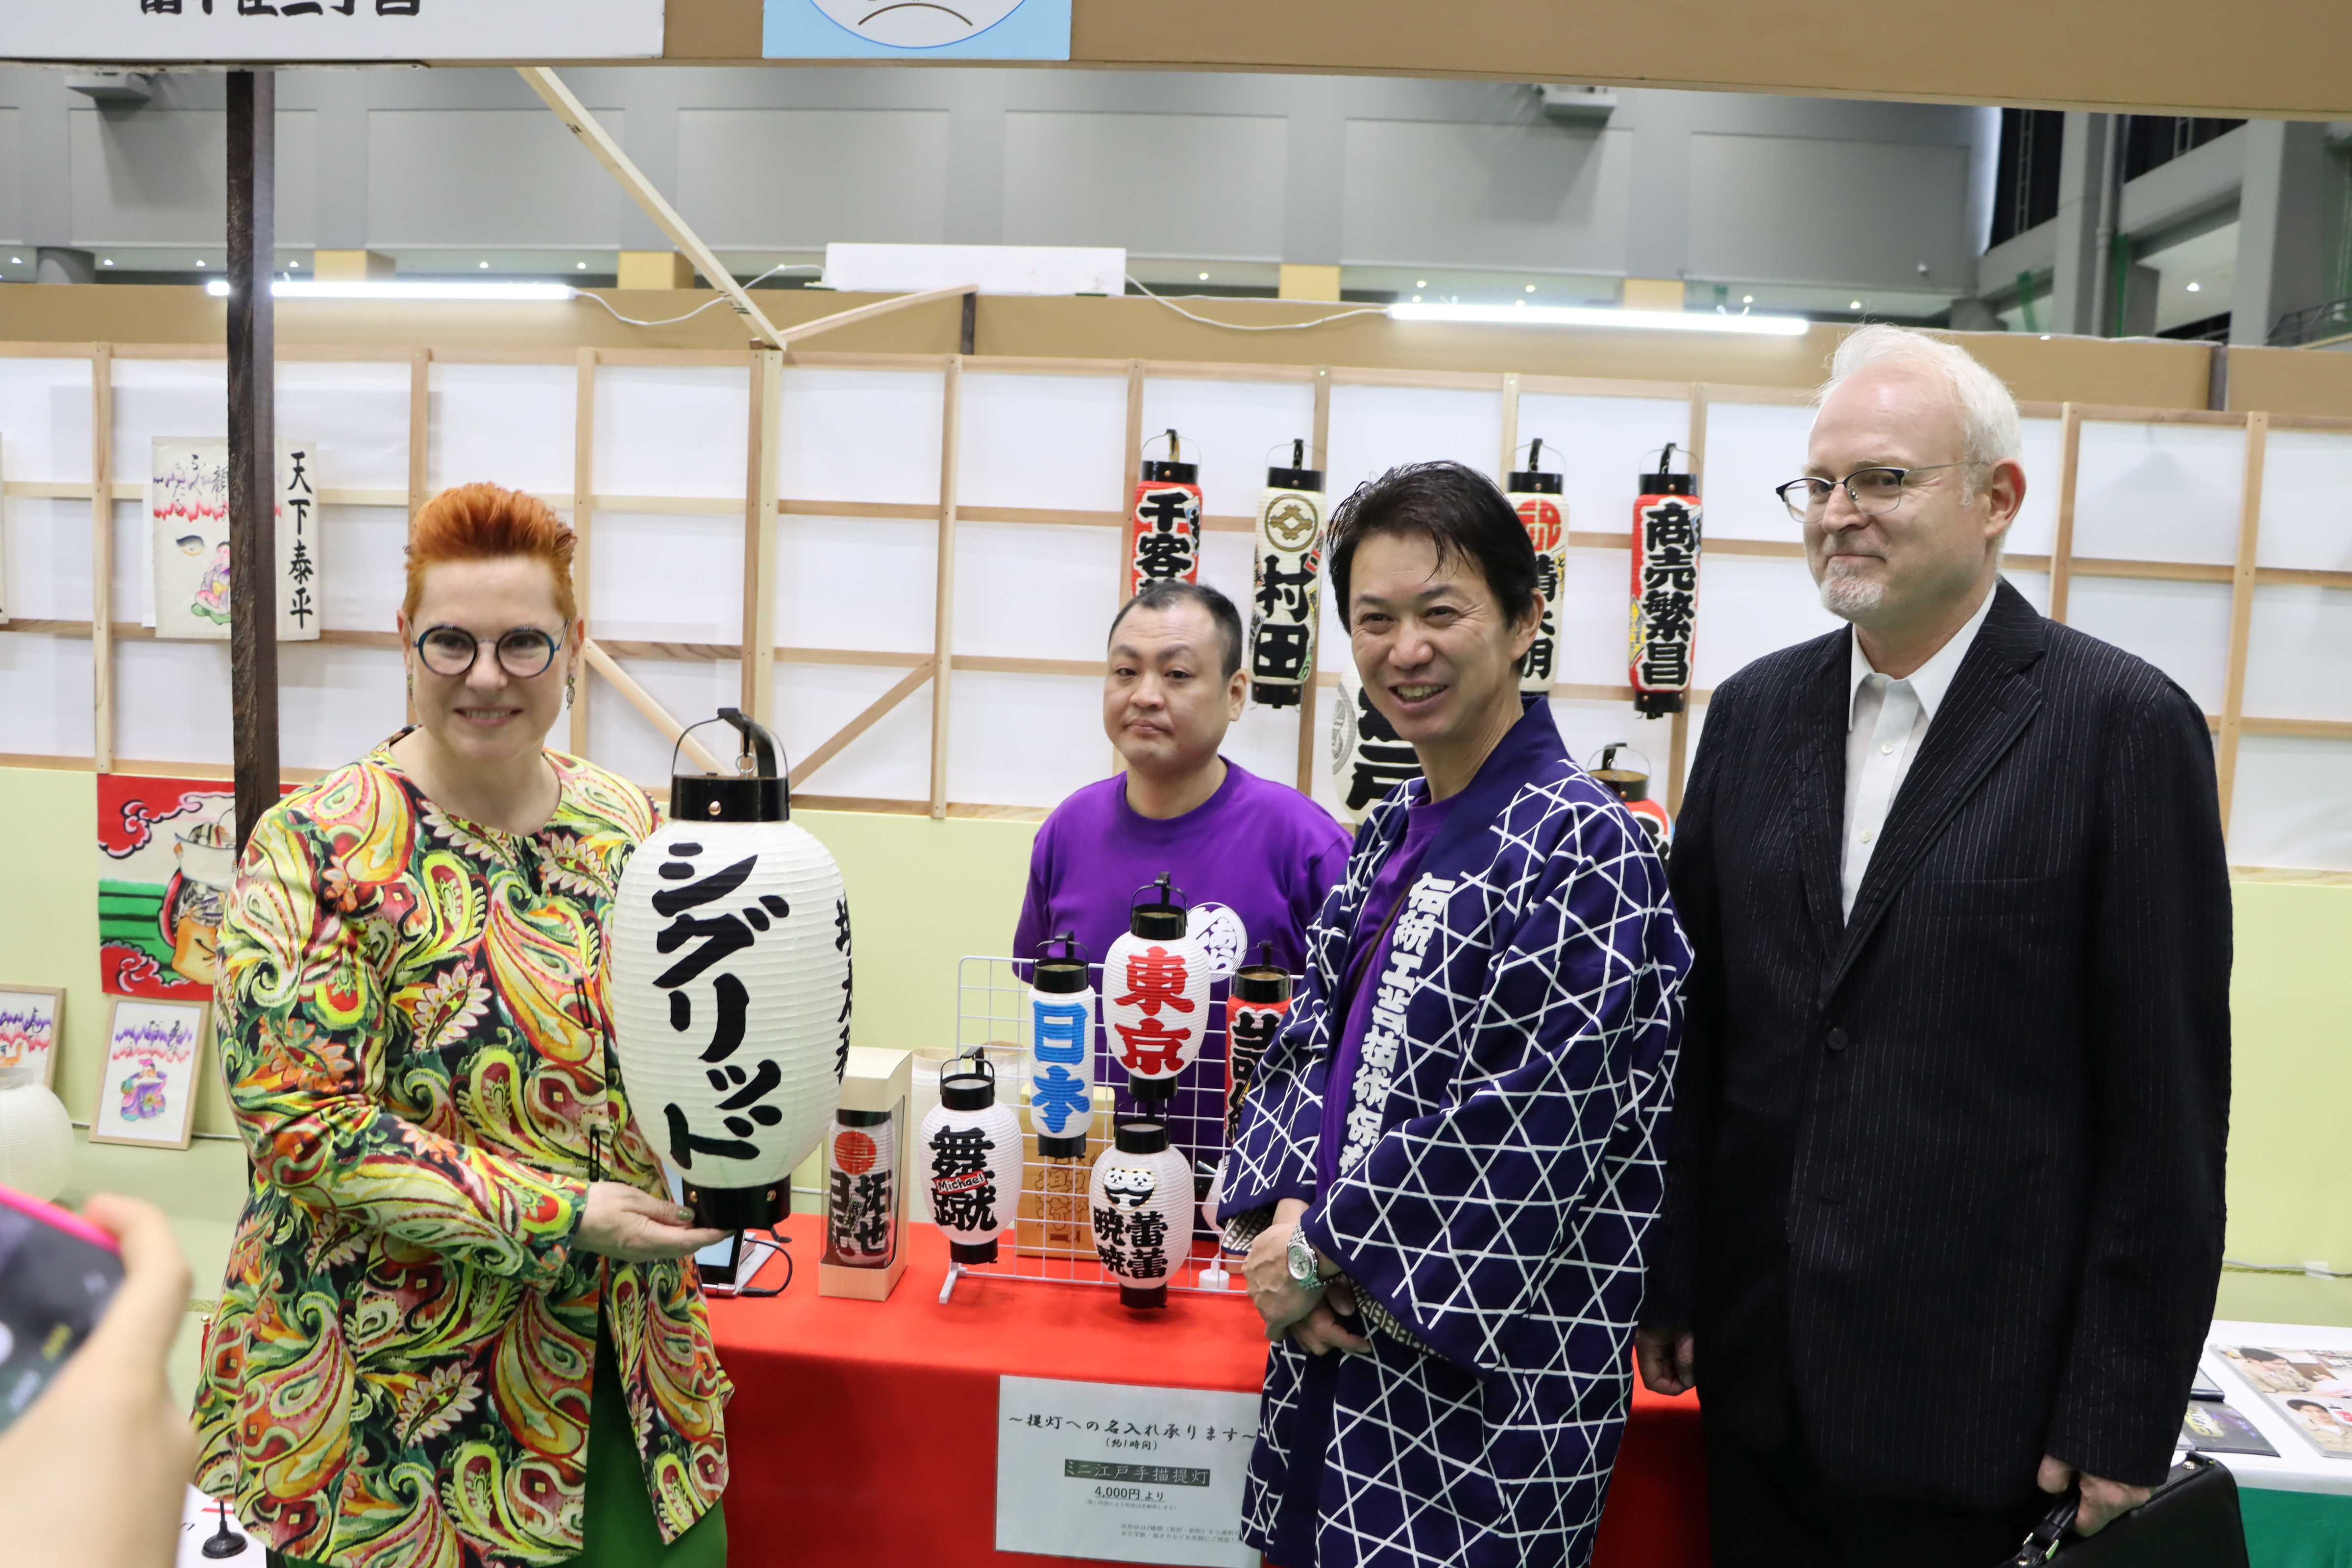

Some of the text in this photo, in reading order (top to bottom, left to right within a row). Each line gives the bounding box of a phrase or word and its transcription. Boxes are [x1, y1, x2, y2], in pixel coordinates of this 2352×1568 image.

[288, 451, 314, 629] 天下泰平
[1135, 492, 1193, 588] 千客
[1642, 502, 1696, 686] 商売繁昌
[1252, 555, 1310, 680] 村田
[652, 842, 789, 1170] シグリッド
[1031, 1001, 1090, 1133] 日本
[1113, 946, 1195, 1075] 東京
[937, 1174, 984, 1191] Michael
[1067, 1460, 1208, 1485] ミニ江戸手描提灯
